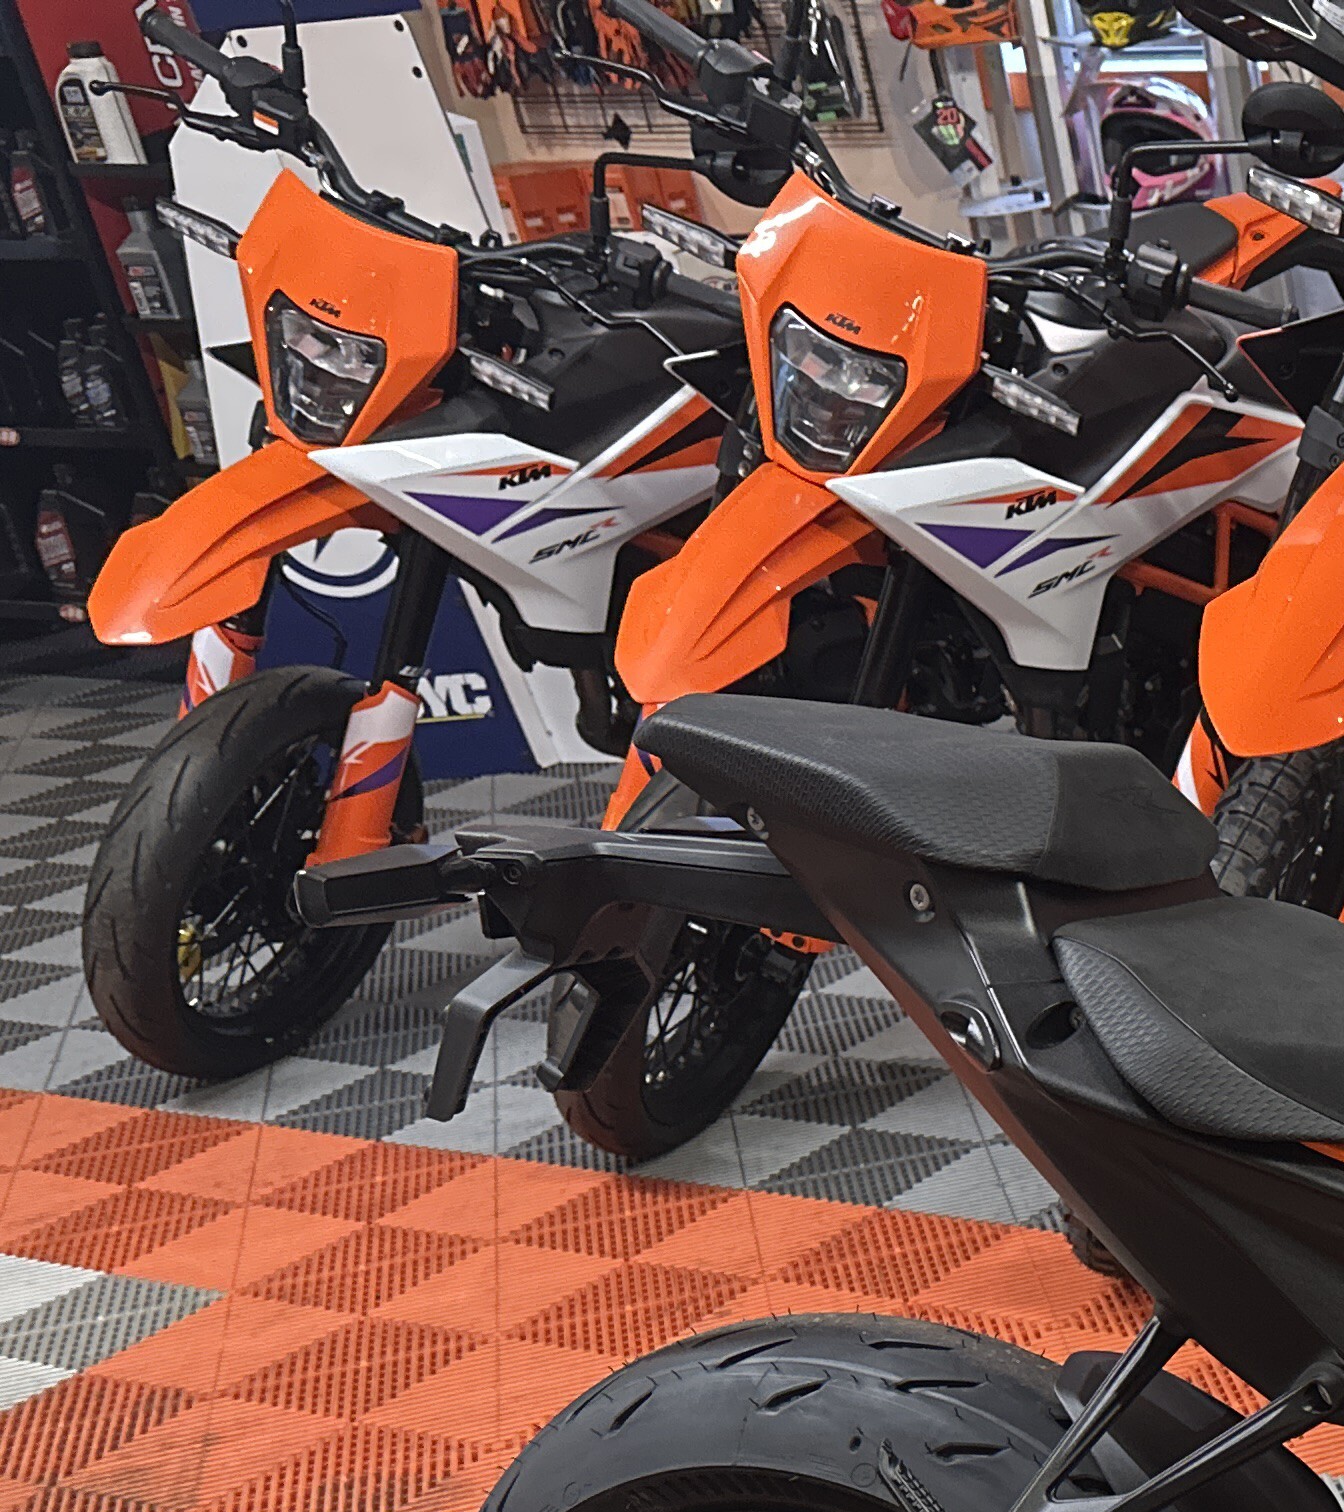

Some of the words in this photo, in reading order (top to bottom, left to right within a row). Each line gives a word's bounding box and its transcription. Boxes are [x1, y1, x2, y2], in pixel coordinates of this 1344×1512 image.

[309, 298, 341, 318] KTM
[825, 312, 861, 335] KTM
[498, 464, 552, 491] KTM
[1005, 490, 1057, 520] KTM
